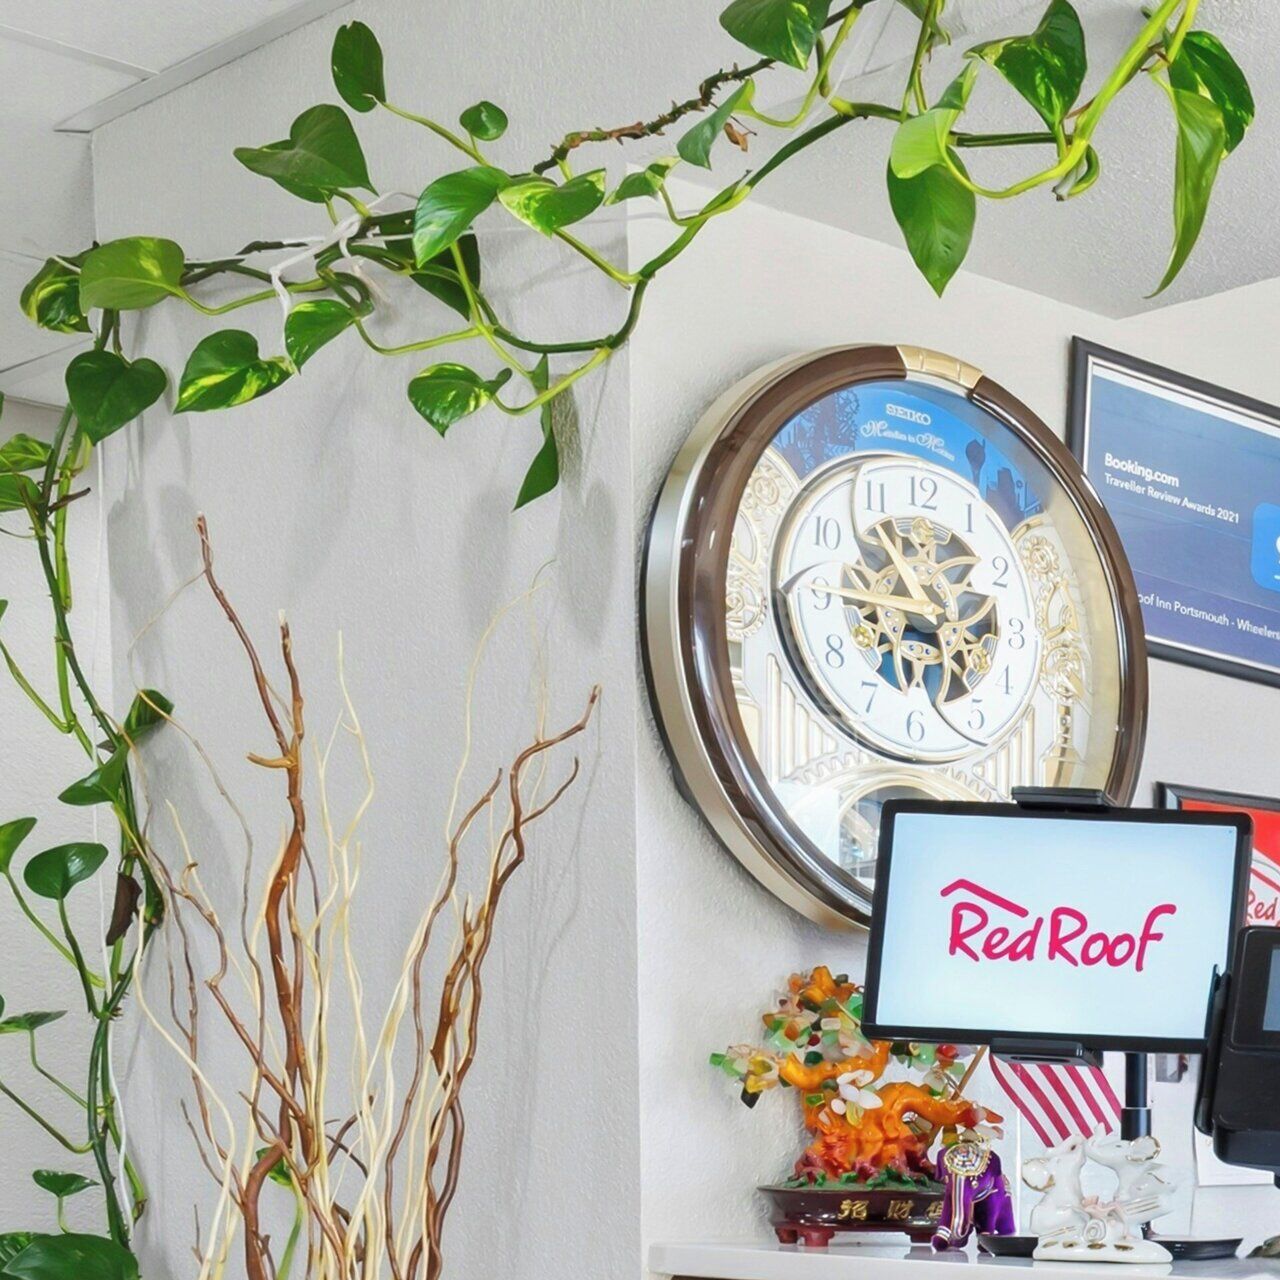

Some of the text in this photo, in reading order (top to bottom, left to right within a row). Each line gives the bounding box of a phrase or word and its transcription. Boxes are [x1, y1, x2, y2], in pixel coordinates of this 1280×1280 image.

[885, 403, 931, 425] SEIKO
[1104, 452, 1179, 487] Booking.com
[866, 480, 886, 513] 11
[908, 475, 938, 511] 12
[1104, 472, 1240, 524] Traveller Review Awards 2021
[814, 516, 841, 550] 10
[965, 503, 975, 534] 1
[991, 556, 1009, 589] 2
[812, 576, 832, 611] 9
[1138, 593, 1155, 605] oof
[1155, 596, 1172, 611] Inn
[1173, 600, 1229, 626] Portsmouth
[1008, 618, 1025, 650] 3
[825, 634, 845, 668] 8
[997, 664, 1014, 696] 4
[860, 680, 879, 714] 7
[906, 710, 925, 743] 6
[967, 698, 985, 731] 5
